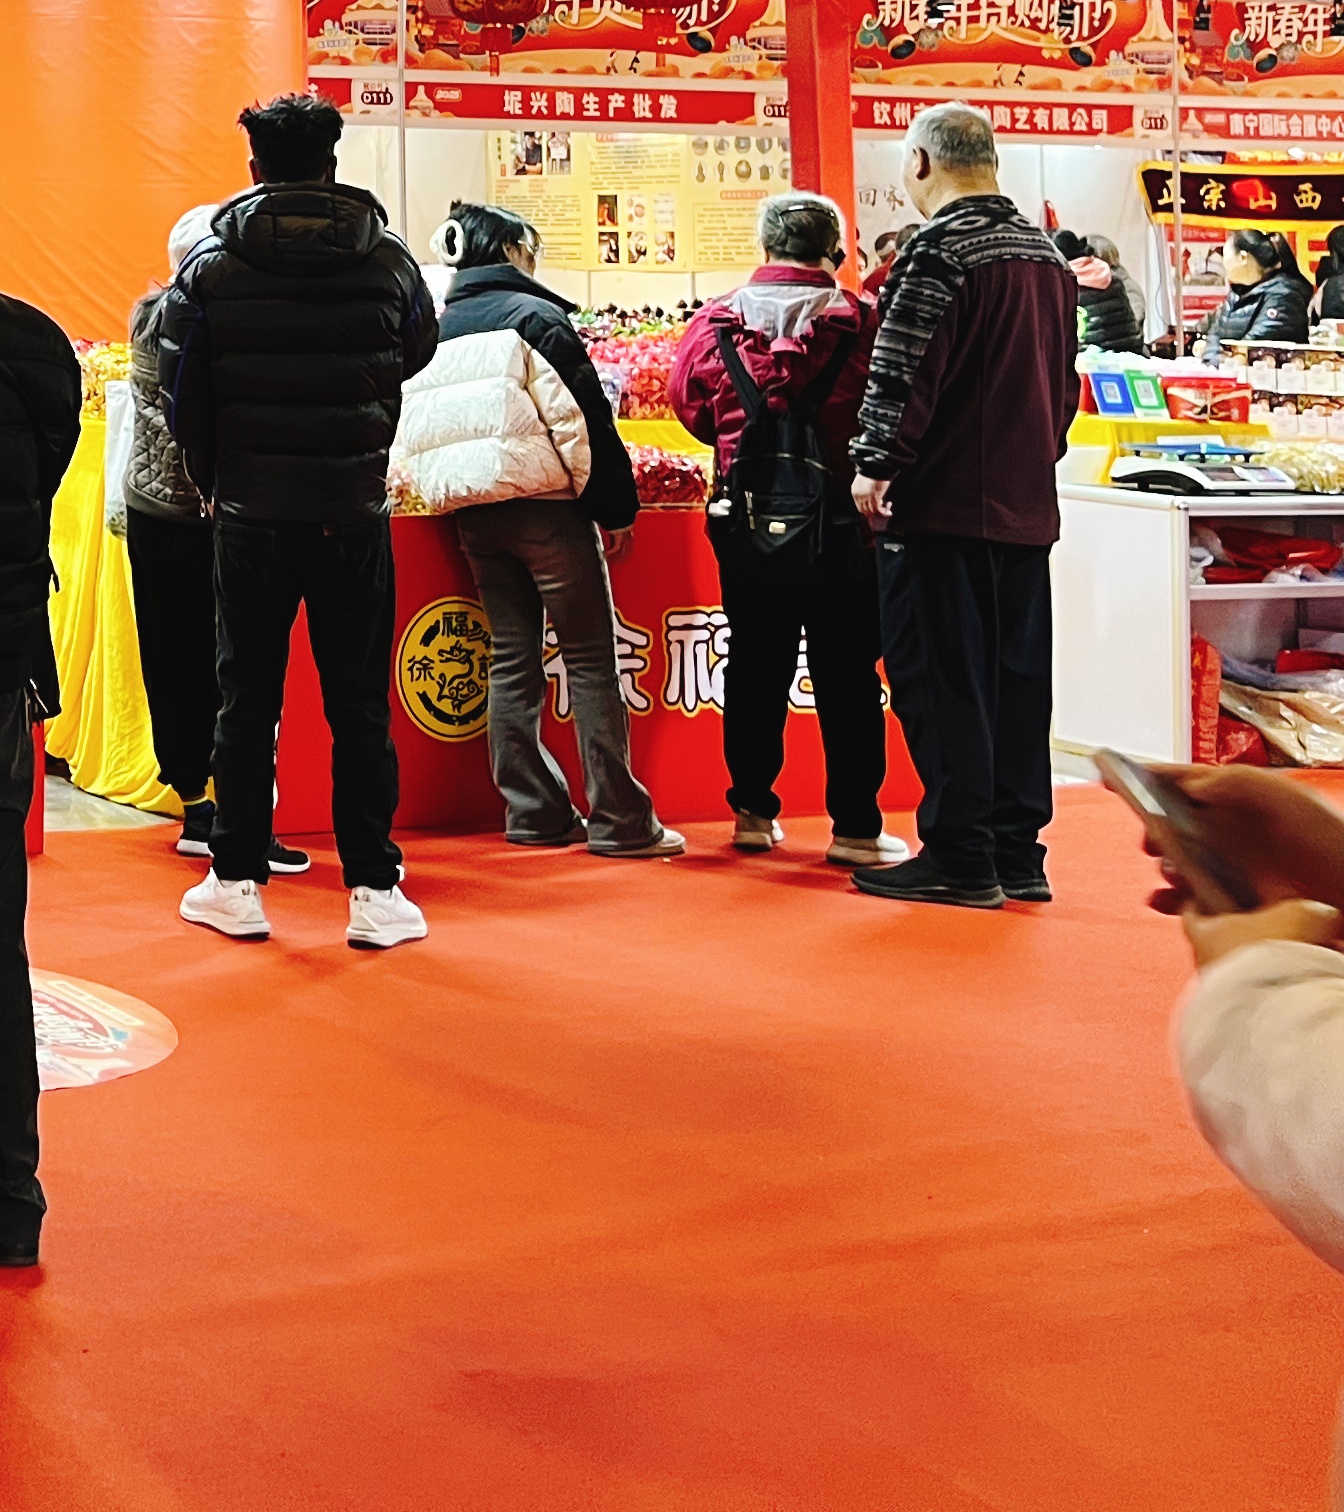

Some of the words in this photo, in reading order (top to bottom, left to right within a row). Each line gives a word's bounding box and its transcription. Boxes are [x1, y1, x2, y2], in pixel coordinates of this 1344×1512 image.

[503, 88, 679, 120] 坭兴陶生产批发
[873, 101, 1109, 134] 钦州陶艺有限公司
[1158, 178, 1323, 211] 正宗山西
